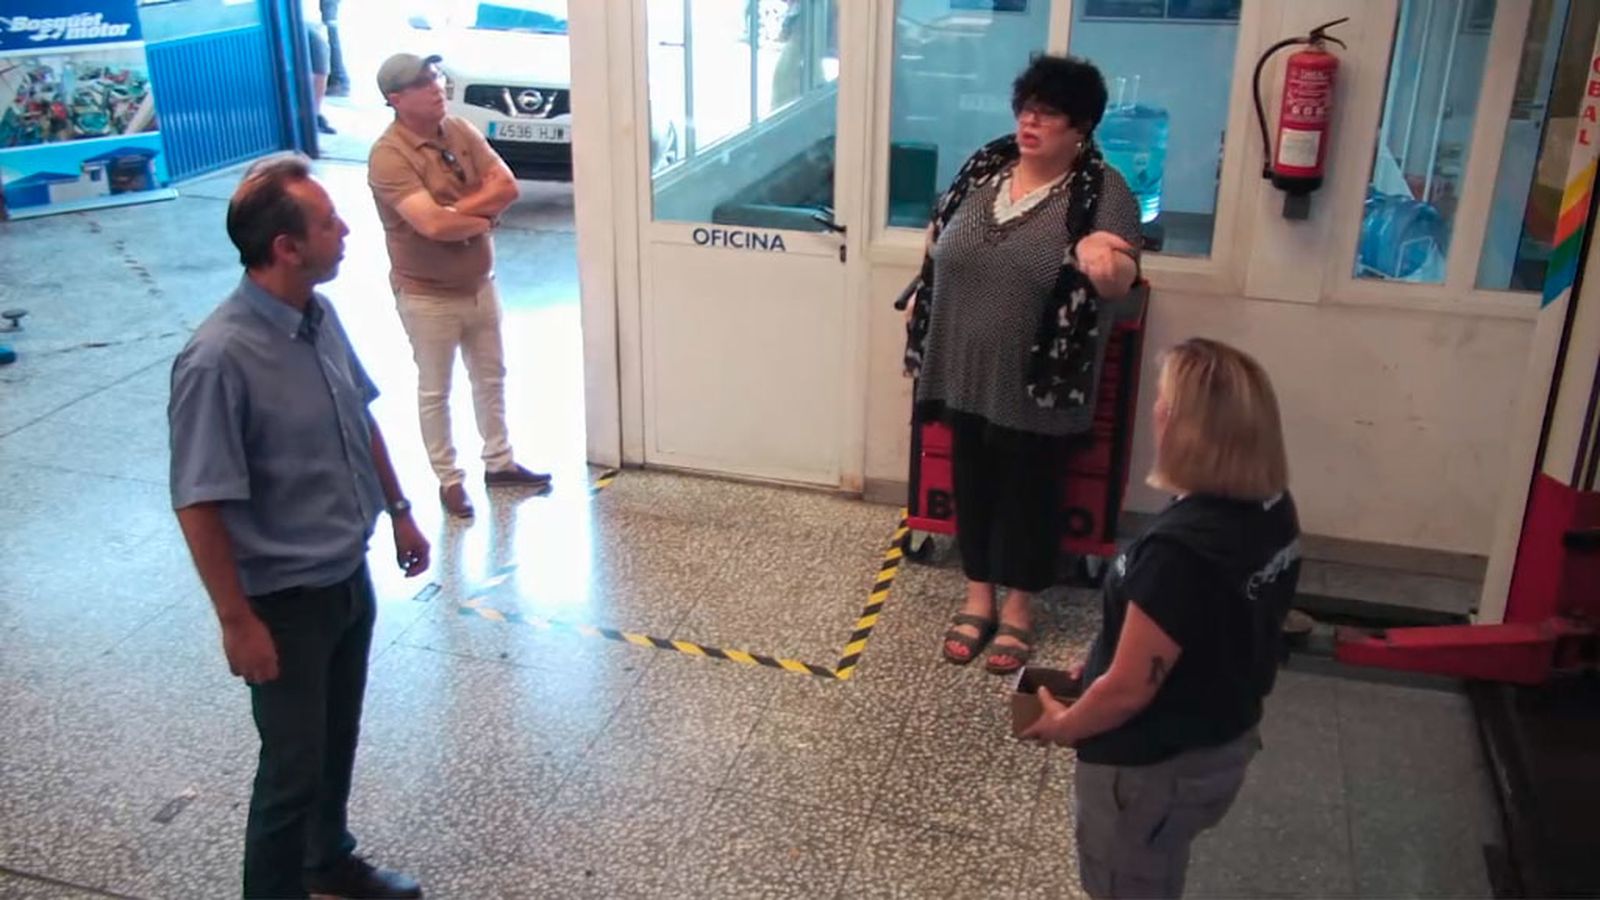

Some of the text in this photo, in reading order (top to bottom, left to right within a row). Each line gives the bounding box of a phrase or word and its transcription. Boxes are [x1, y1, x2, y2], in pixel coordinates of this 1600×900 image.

[7, 12, 104, 38] Bosquet
[65, 22, 131, 40] motor
[499, 123, 532, 139] 4536
[692, 227, 786, 252] OFICINA
